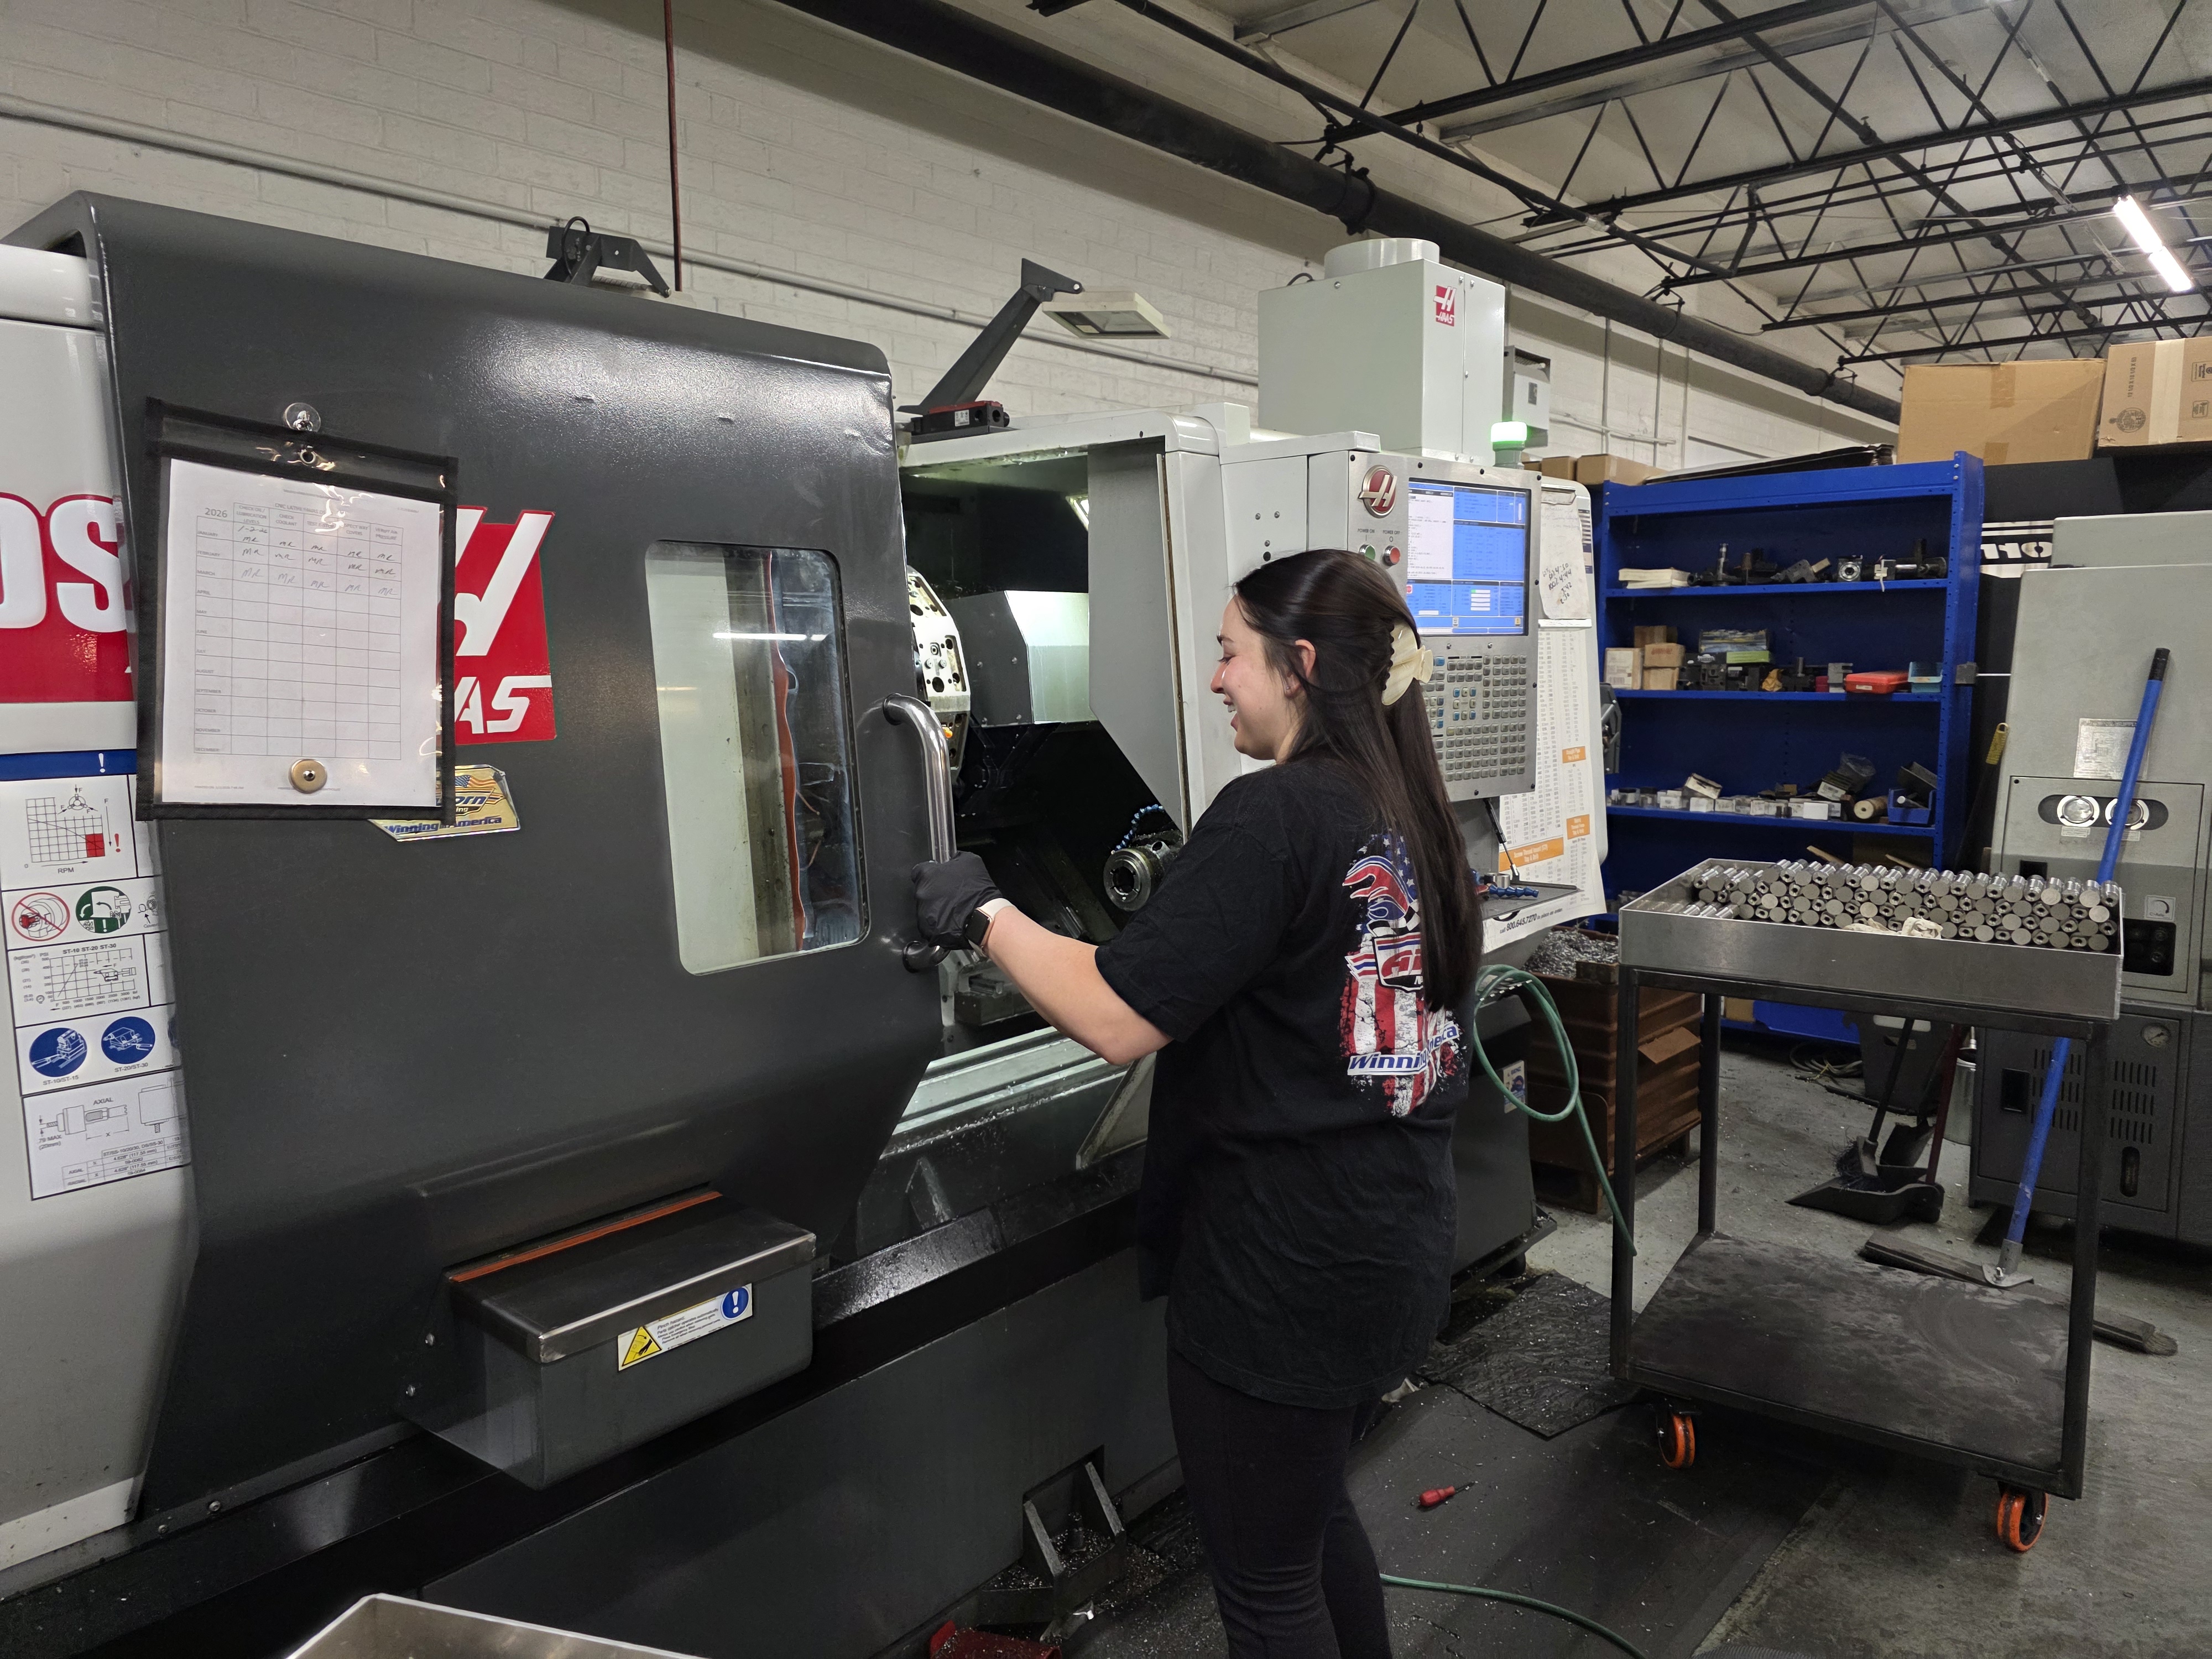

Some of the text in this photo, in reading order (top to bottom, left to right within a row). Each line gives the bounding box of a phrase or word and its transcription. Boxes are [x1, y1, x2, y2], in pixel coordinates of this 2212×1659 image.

[1436, 311, 1454, 324] HAAS
[205, 507, 227, 518] 2026
[241, 567, 262, 578] MR
[278, 573, 295, 585] MR
[311, 580, 329, 588] MR
[455, 676, 552, 734] AS
[385, 823, 439, 834] Winning
[1506, 913, 1537, 931] 800.645.7270
[114, 1062, 148, 1072] ST-20/ST-30
[43, 1075, 79, 1086] ST-10/ST-15
[93, 1097, 113, 1105] AXIAL
